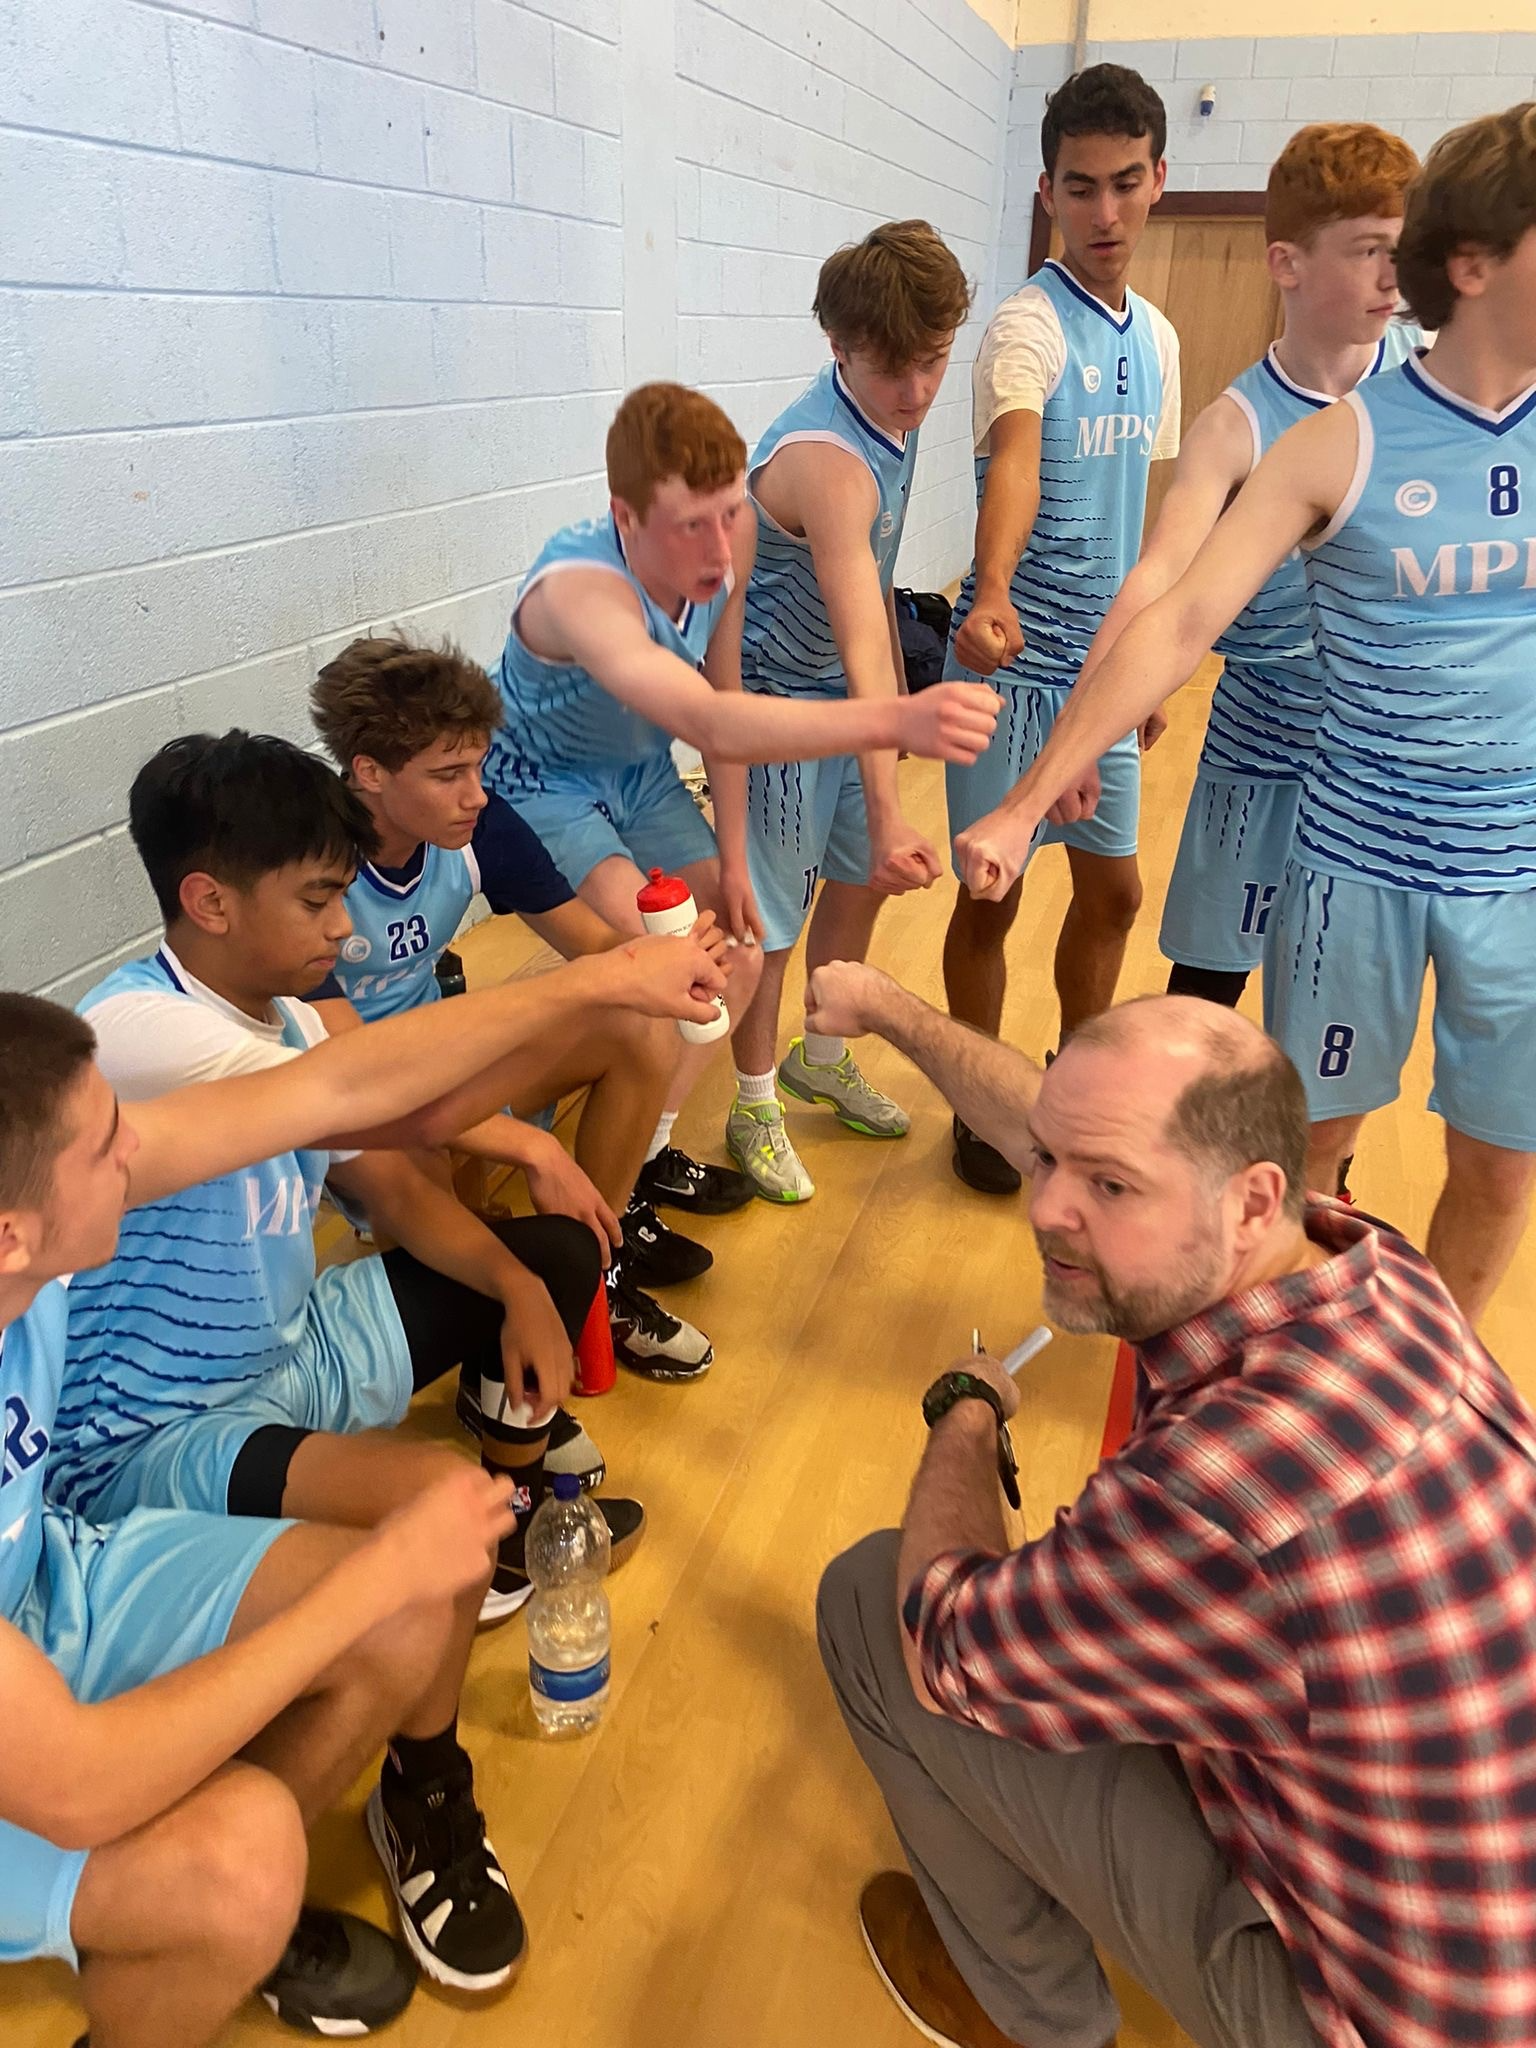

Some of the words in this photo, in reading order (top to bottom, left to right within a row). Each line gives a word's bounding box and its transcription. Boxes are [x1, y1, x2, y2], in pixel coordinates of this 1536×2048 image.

[1115, 354, 1128, 397] 9
[1074, 413, 1155, 459] MPPS
[1488, 461, 1521, 520] 8
[801, 864, 819, 911] 11
[1239, 881, 1277, 935] 12
[385, 913, 431, 963] 23
[1317, 1022, 1355, 1079] 8
[0, 1394, 50, 1490] 2
